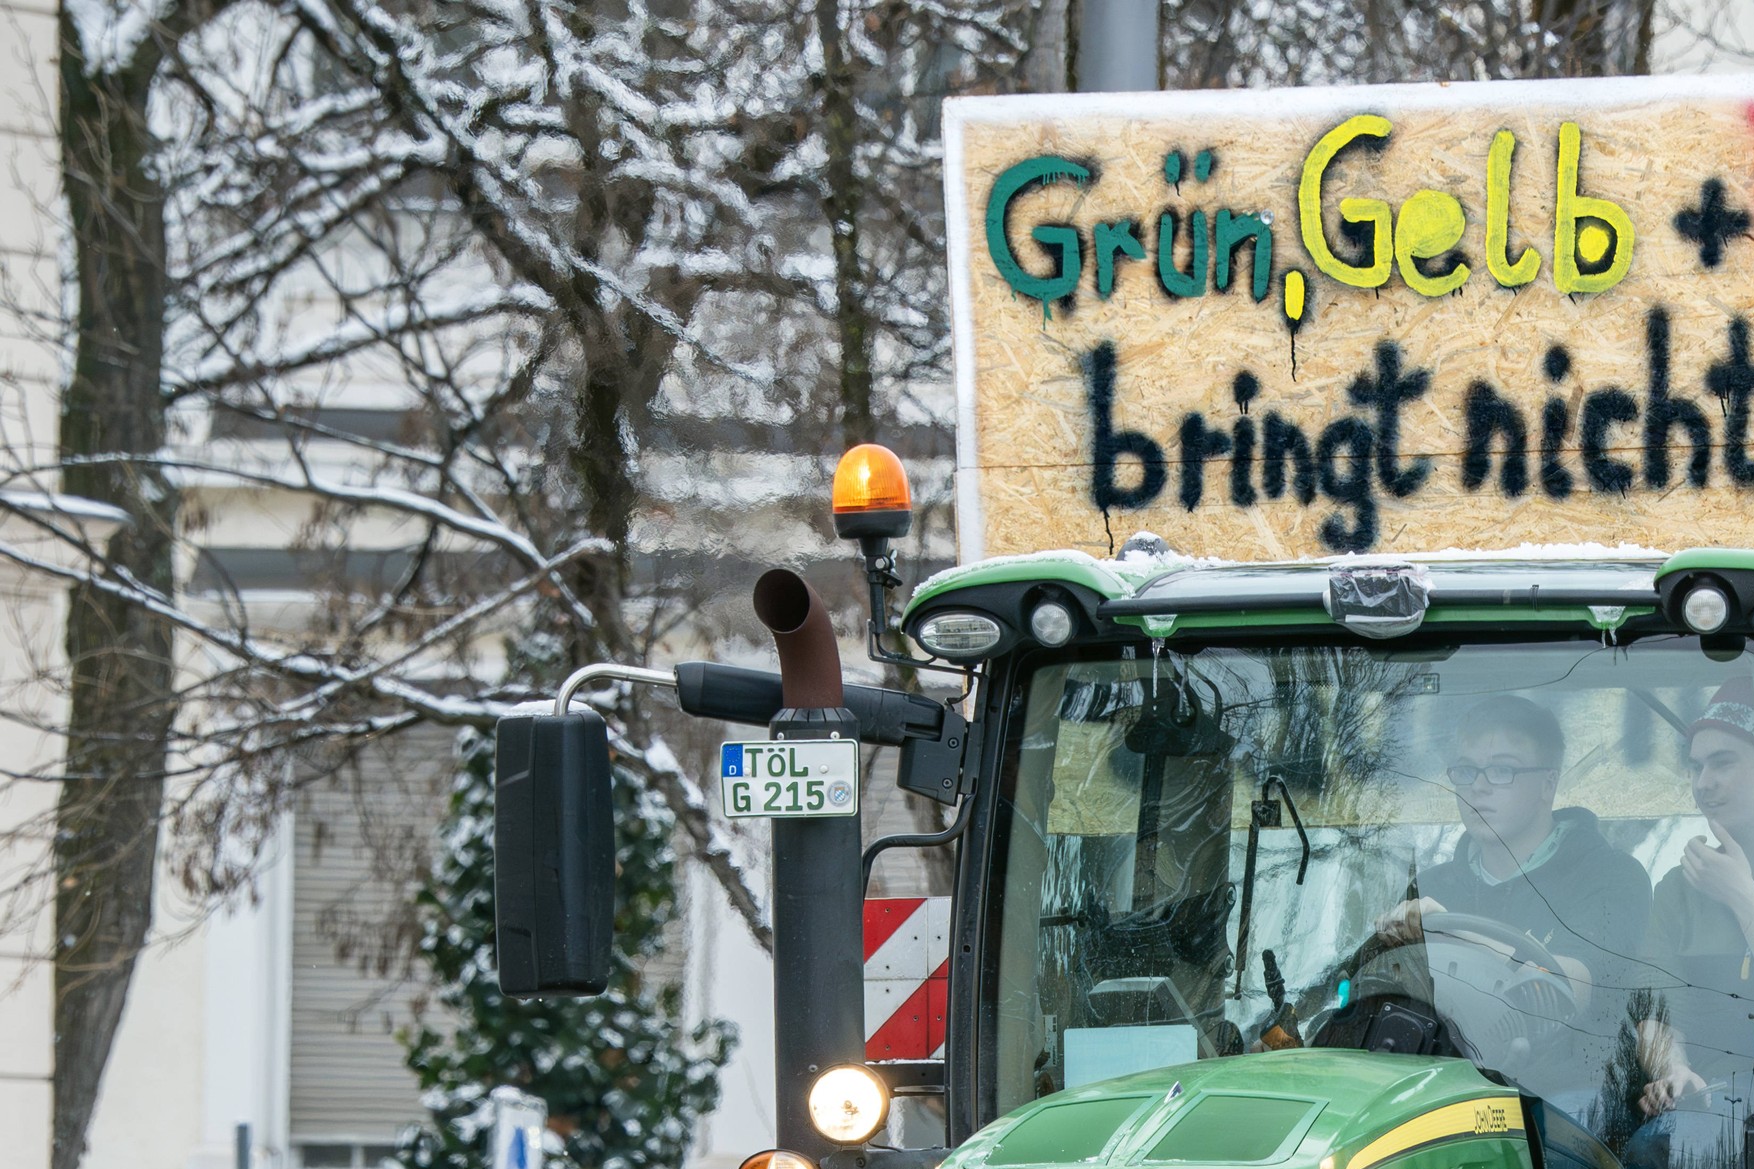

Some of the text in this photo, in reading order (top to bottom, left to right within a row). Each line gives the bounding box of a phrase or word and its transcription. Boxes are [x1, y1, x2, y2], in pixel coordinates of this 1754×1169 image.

[1300, 113, 1635, 297] Gelb
[1088, 338, 1430, 550] bringt
[728, 765, 737, 776] D
[744, 747, 809, 778] TÖL
[732, 780, 826, 812] G 215
